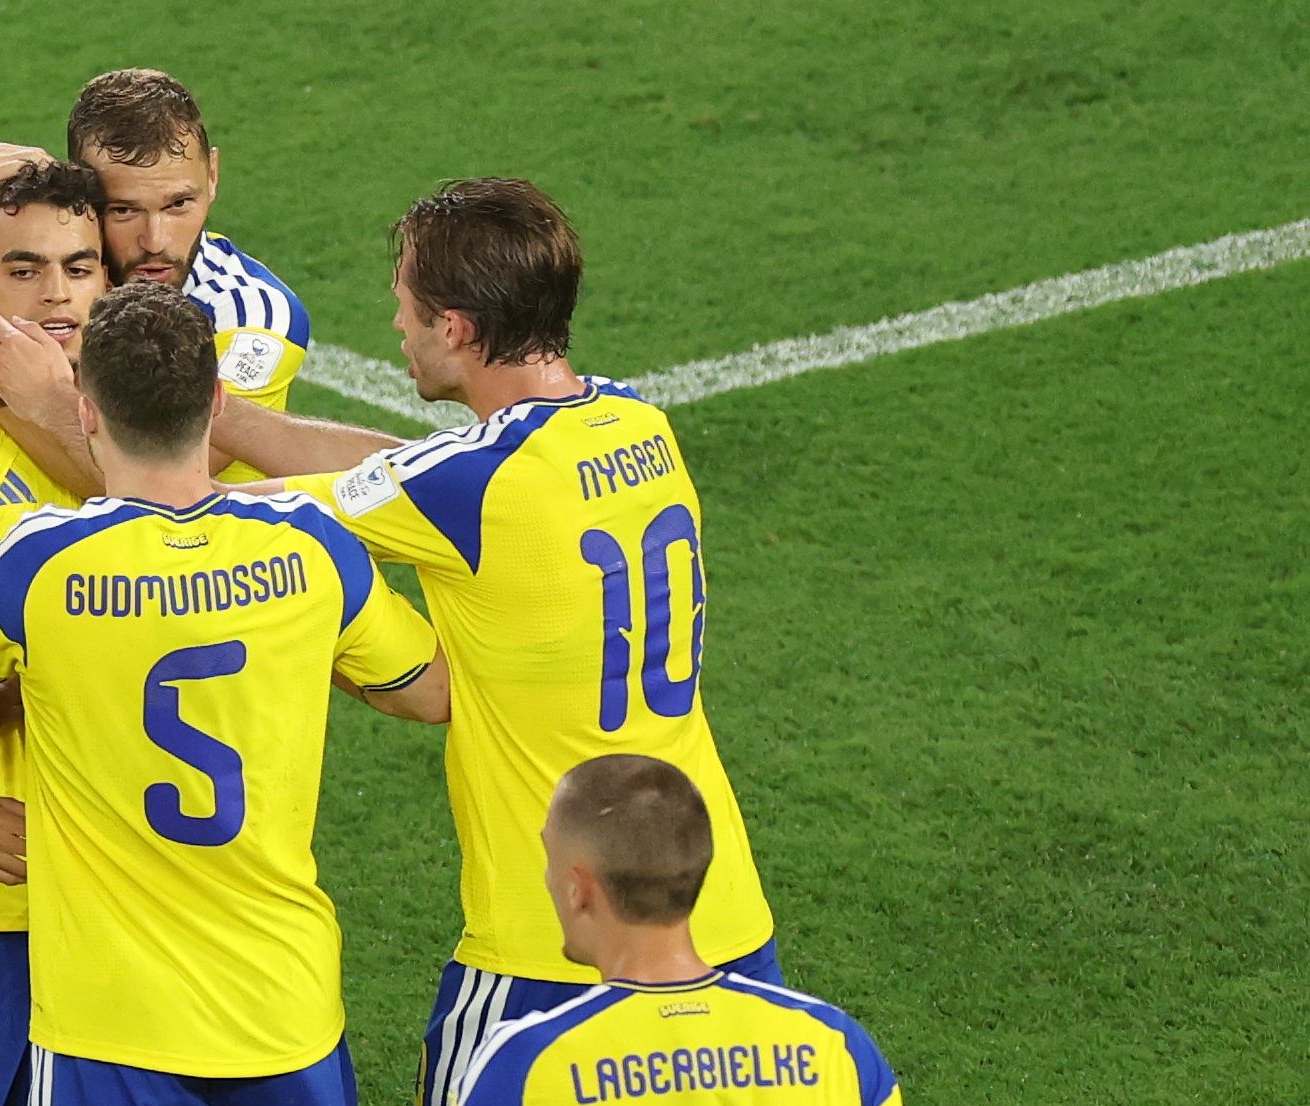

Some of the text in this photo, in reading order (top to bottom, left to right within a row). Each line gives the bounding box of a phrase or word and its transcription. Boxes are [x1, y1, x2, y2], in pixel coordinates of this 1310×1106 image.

[577, 434, 676, 500] NYGREN
[65, 551, 308, 618] GUDMUNDSSON
[580, 503, 706, 733] 10
[143, 639, 247, 847] 5
[570, 1044, 819, 1105] LAGERBIELKE
